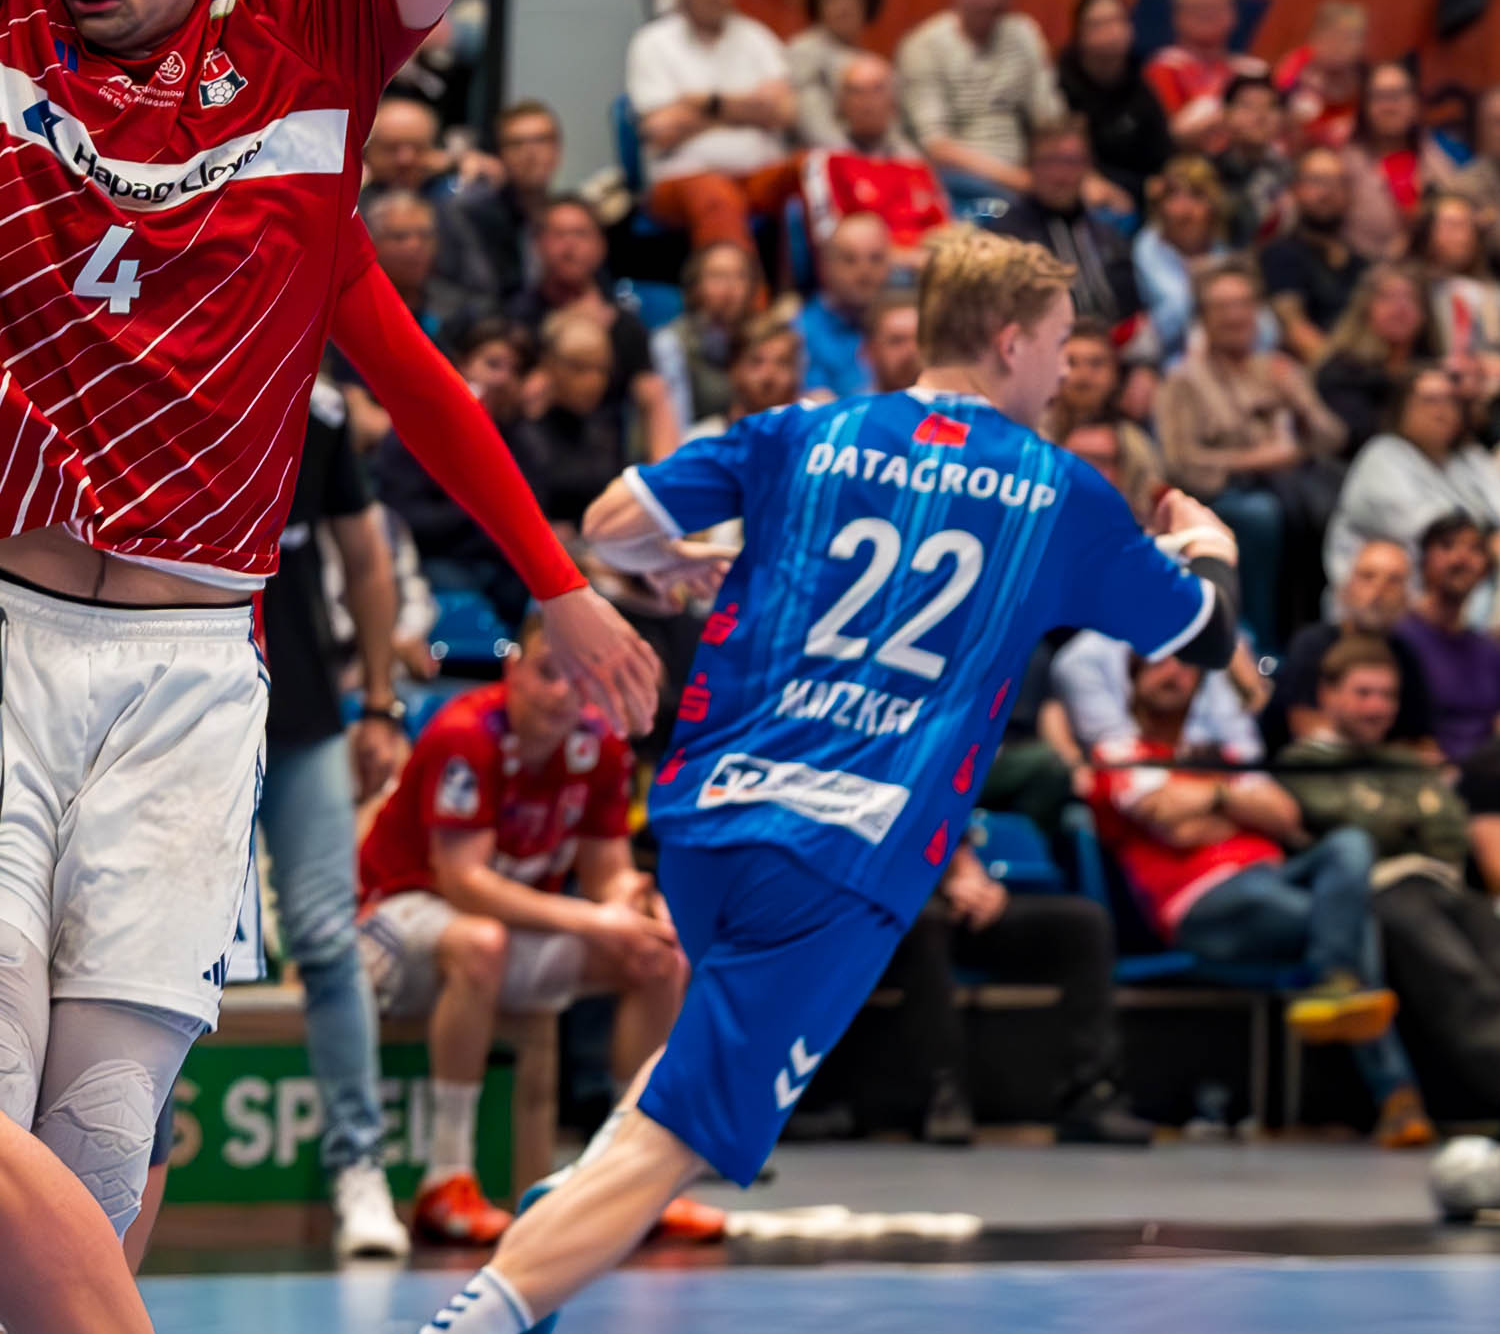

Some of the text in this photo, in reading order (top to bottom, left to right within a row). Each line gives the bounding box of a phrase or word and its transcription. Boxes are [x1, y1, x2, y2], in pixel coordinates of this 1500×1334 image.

[73, 141, 263, 204] HapagLloyd
[73, 224, 141, 314] 4
[805, 443, 1057, 513] DATAGROUP
[803, 516, 984, 680] 22
